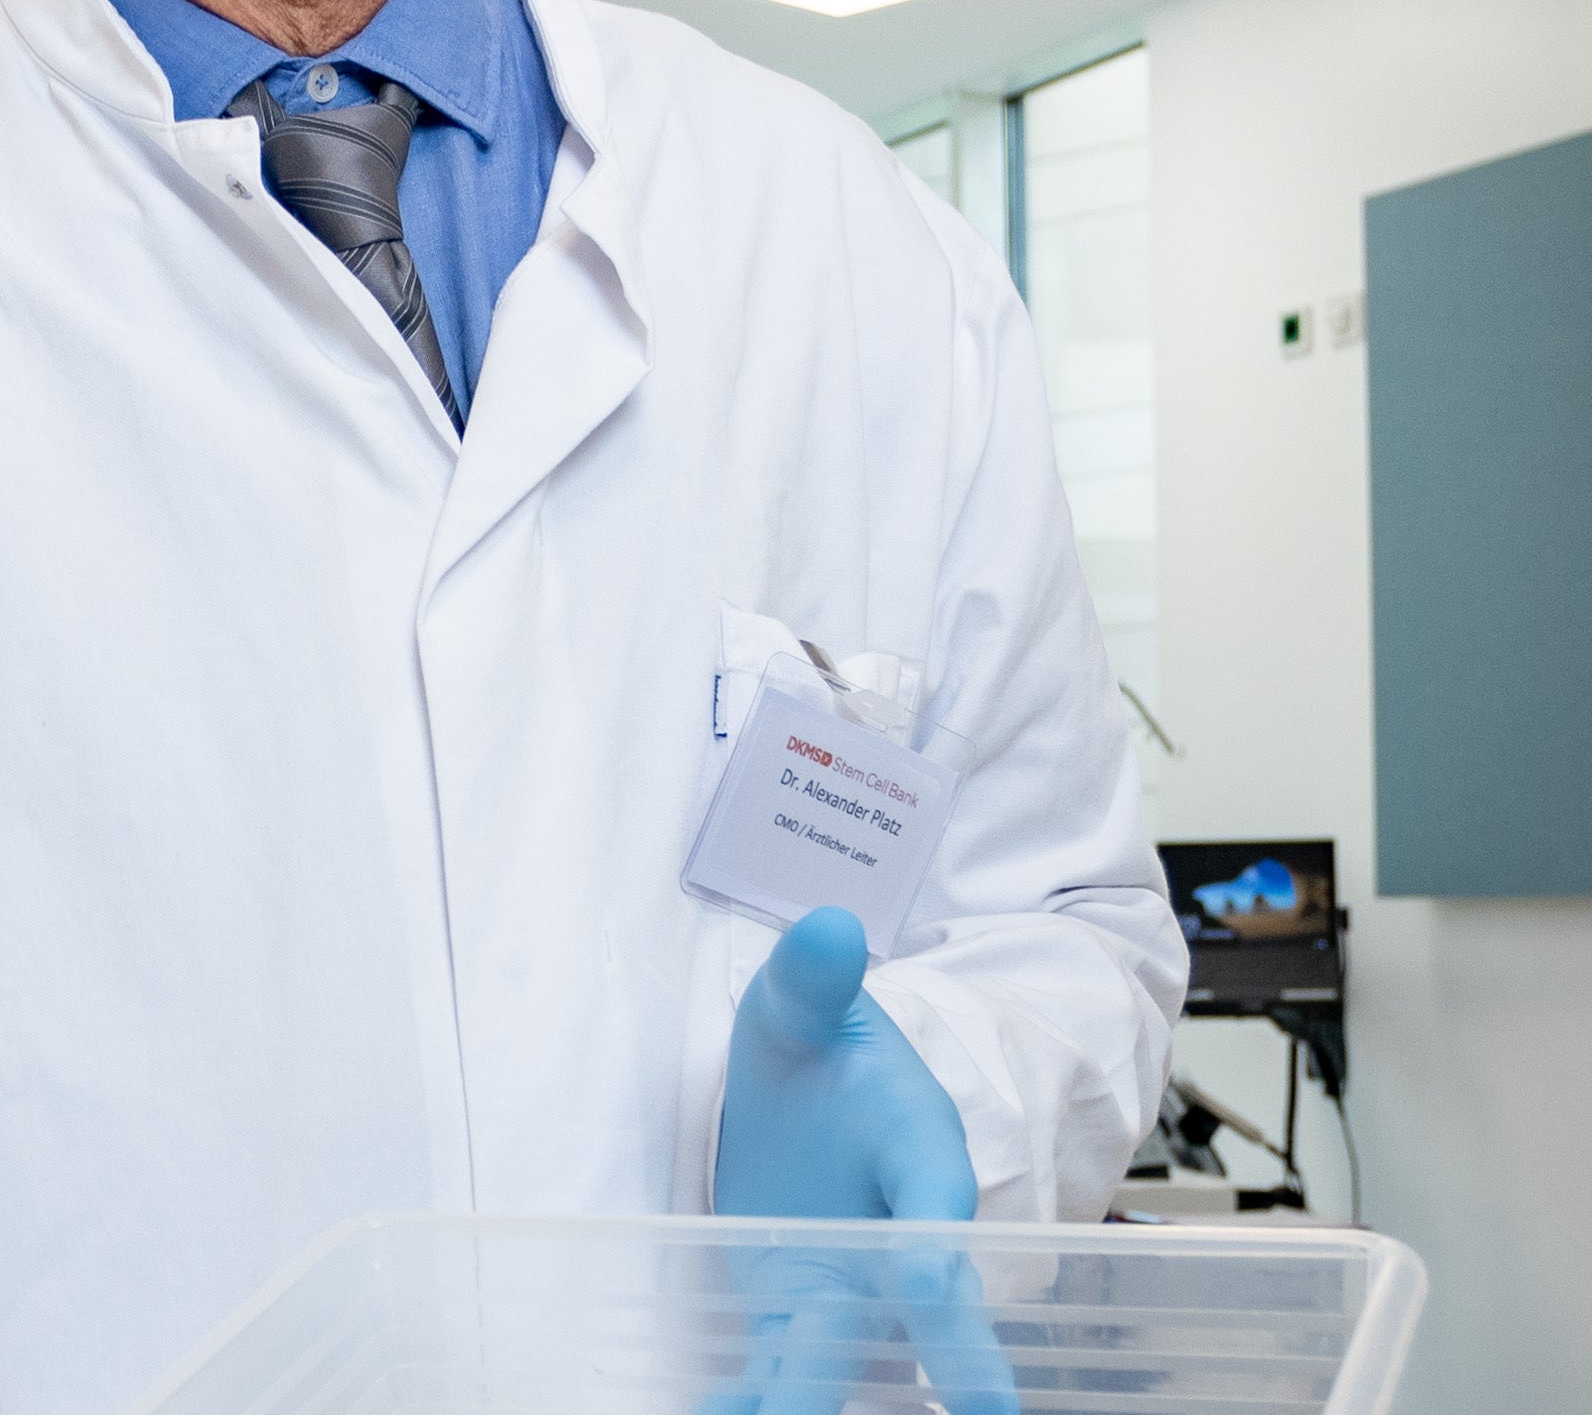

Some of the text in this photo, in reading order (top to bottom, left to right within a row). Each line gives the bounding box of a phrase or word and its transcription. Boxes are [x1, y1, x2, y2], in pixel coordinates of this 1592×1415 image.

[780, 768, 903, 837] Dr. Alexander Platz
[786, 735, 919, 808] DKMS Stem Cell Bank
[774, 813, 799, 833] CMO
[805, 824, 851, 855] Ärztlicher
[850, 847, 878, 868] Leiter
